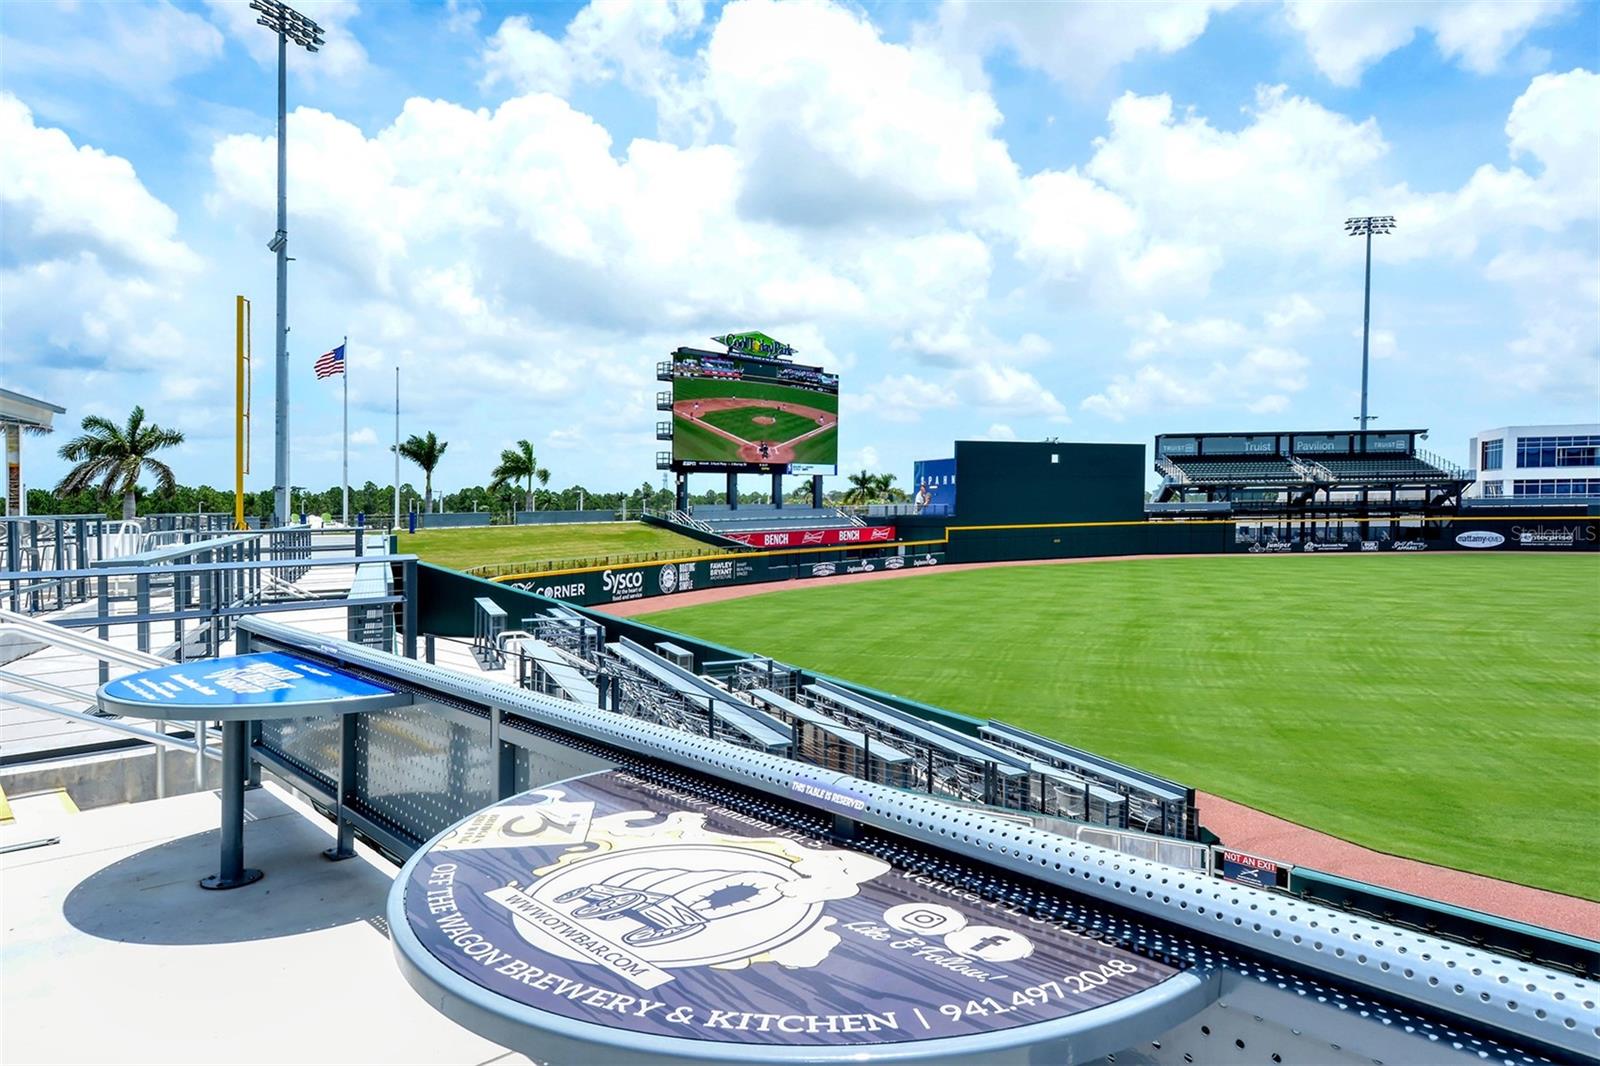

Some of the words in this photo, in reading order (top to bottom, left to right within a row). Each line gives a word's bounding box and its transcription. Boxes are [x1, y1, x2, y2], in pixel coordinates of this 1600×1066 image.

[1244, 441, 1271, 451] Truist
[1296, 441, 1335, 451] Pavilion
[764, 533, 789, 546] BENCH
[839, 530, 860, 541] BENCH
[710, 562, 733, 570] FAWLEY
[710, 568, 733, 577] BRYANT
[603, 570, 642, 594] Sysco
[792, 781, 805, 793] THIS
[805, 785, 826, 799] TABLE
[824, 790, 832, 801] IS
[831, 792, 865, 810] RESERVED
[1224, 852, 1241, 864] NOT
[1242, 857, 1255, 867] AN
[1257, 860, 1277, 871] EXIT
[428, 863, 458, 885] OFF
[901, 869, 982, 905] Venice,
[427, 886, 458, 914] THE
[436, 912, 511, 967] WAGON
[505, 894, 650, 978] WWW.OTWBAR.COM
[842, 921, 891, 942] Like
[912, 945, 1009, 983] Follow!
[494, 959, 667, 1018] BREWERY
[939, 958, 1138, 1022] 941.497.2048
[665, 1006, 694, 1025] &
[703, 1009, 899, 1033] KITCHEN
